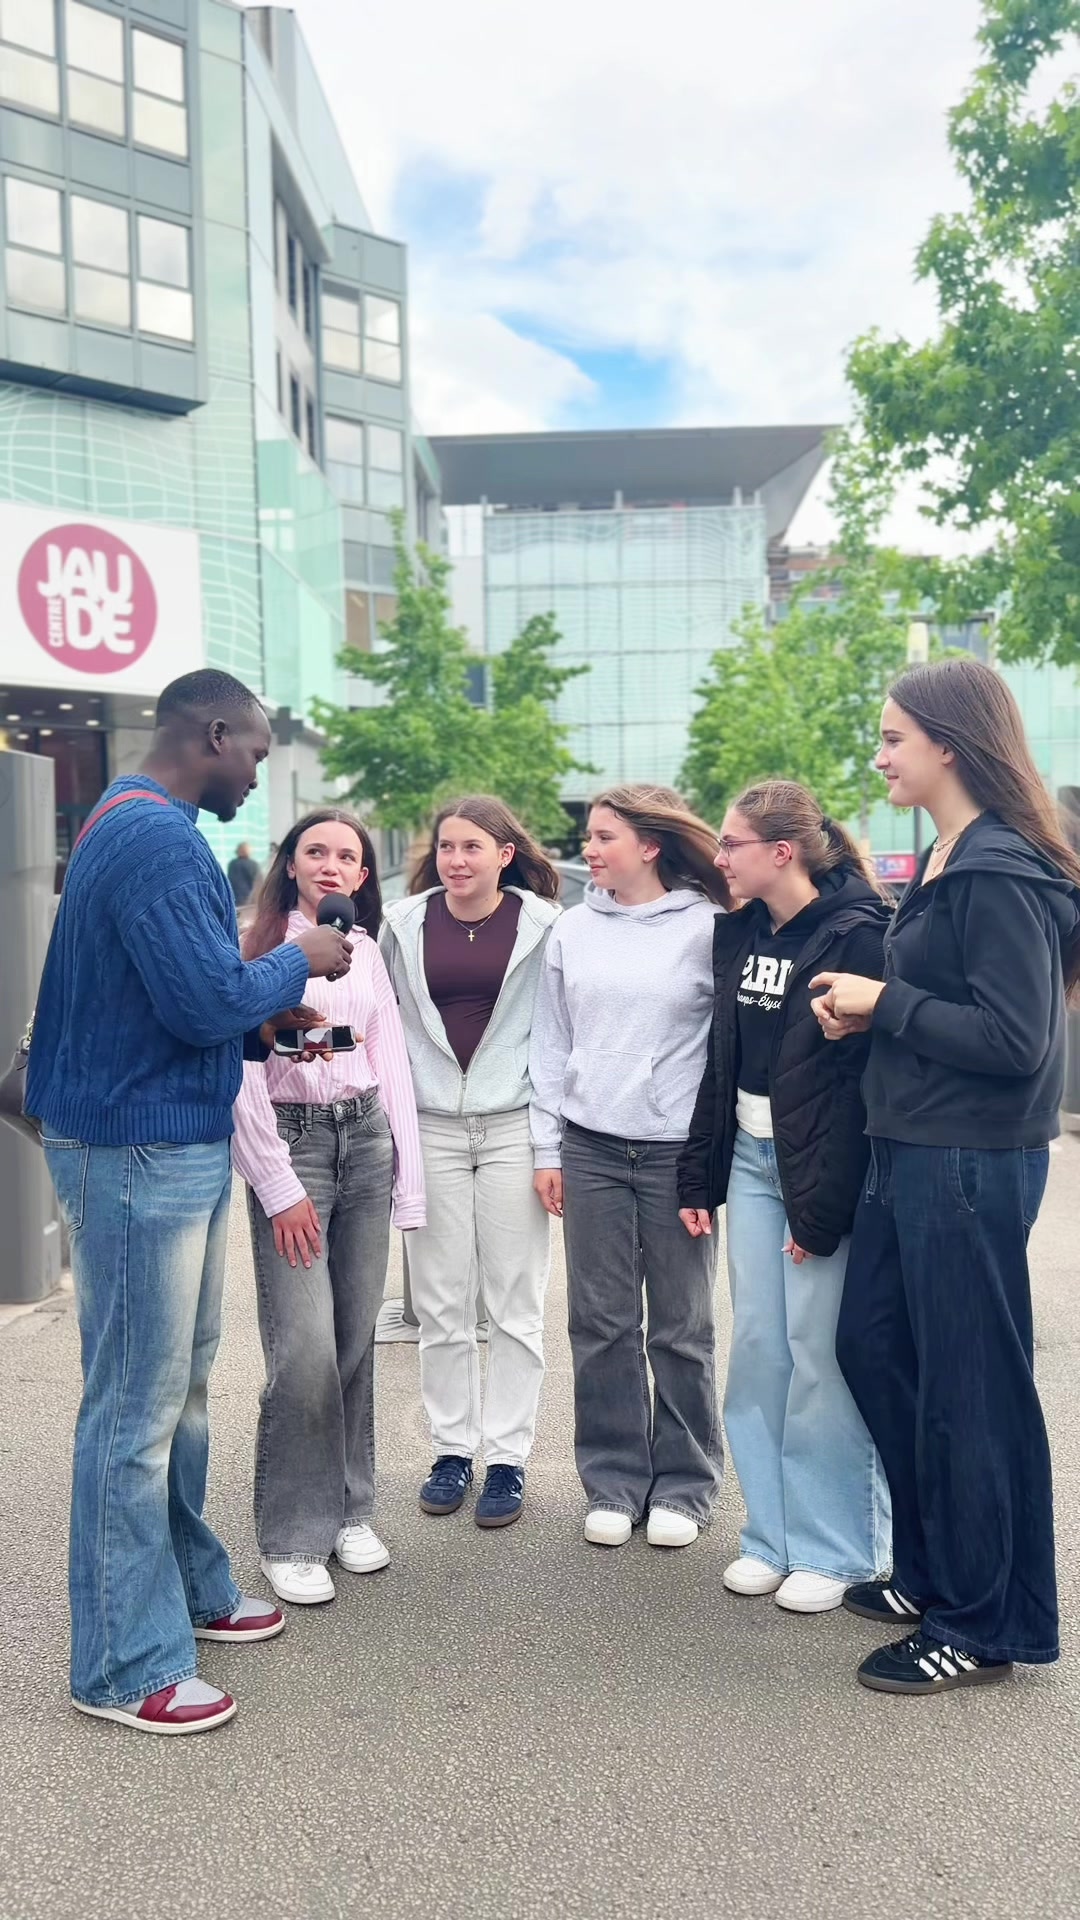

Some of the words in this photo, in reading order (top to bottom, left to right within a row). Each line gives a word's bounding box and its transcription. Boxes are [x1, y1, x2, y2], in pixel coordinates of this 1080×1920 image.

[37, 544, 133, 601] JAU
[47, 598, 64, 648] CENTRE
[66, 594, 135, 654] DE
